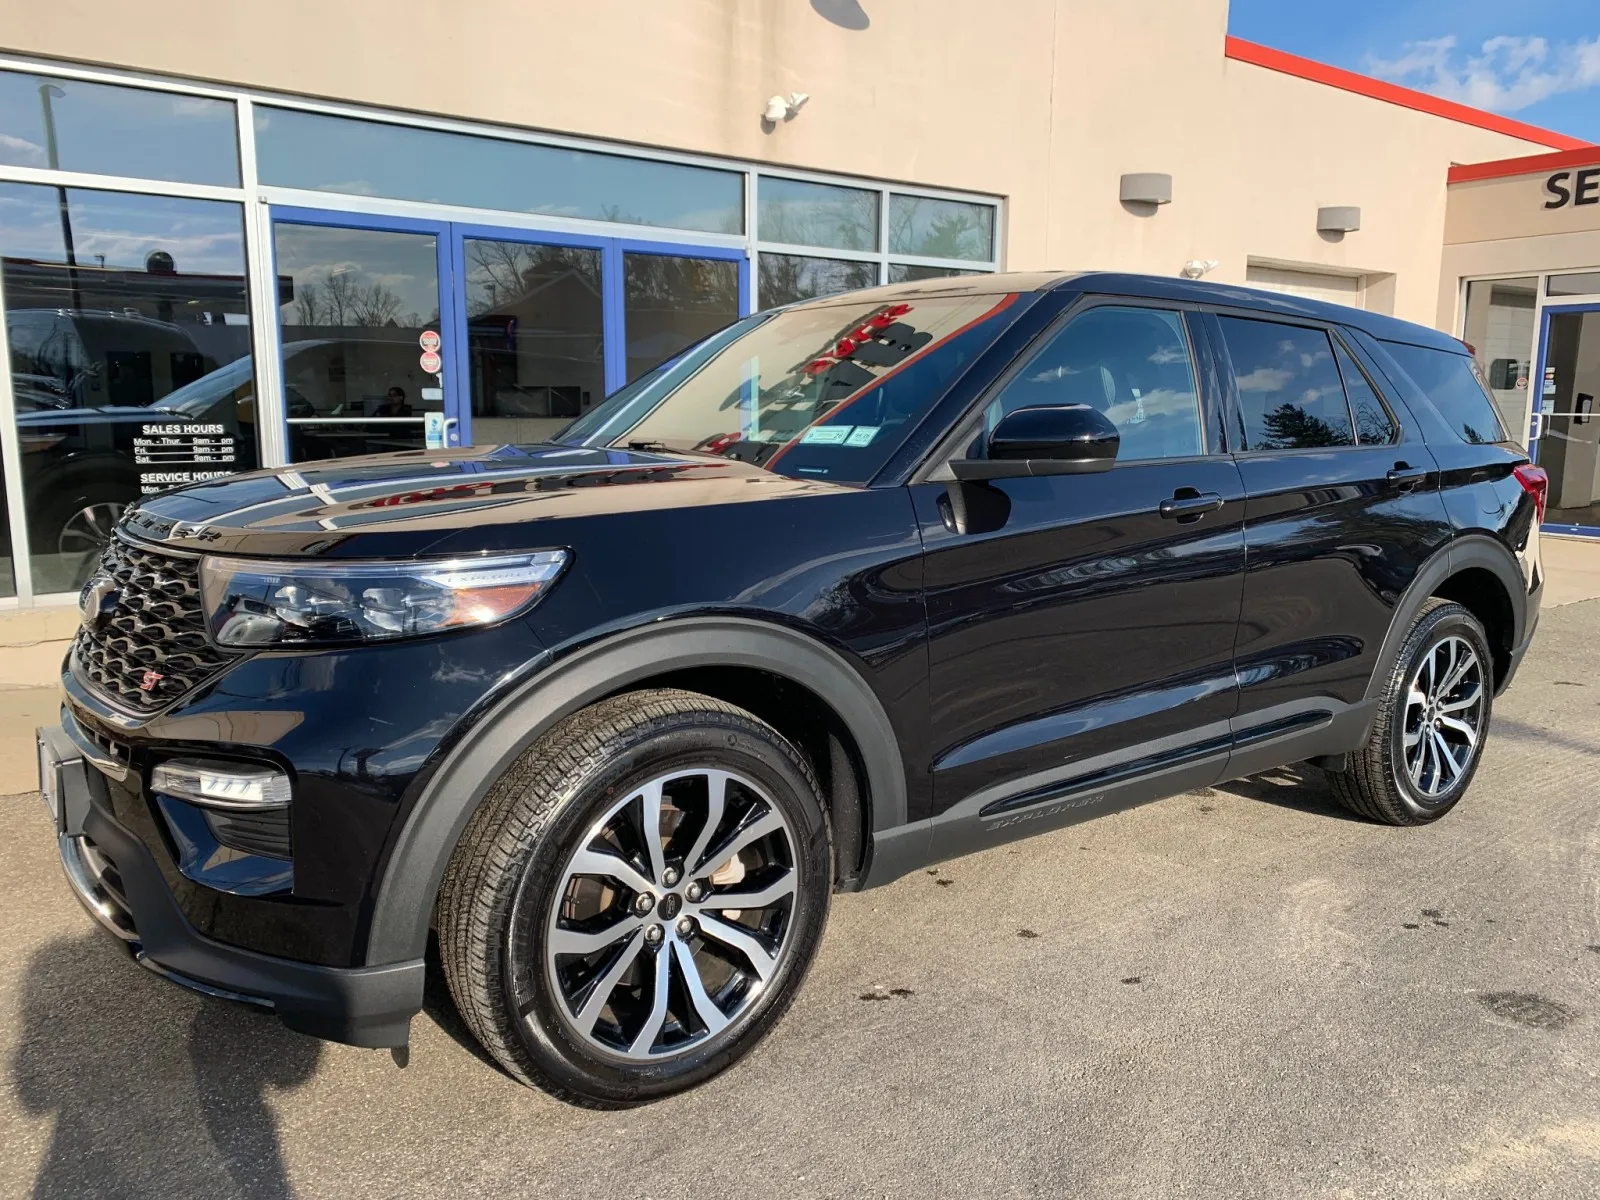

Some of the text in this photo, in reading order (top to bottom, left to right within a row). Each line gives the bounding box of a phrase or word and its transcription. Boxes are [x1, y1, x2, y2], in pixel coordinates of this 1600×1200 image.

[1545, 168, 1600, 209] SE
[142, 424, 224, 434] SALES HOURS
[193, 437, 210, 445] 9am
[140, 472, 190, 483] SERVICE
[140, 671, 164, 691] ST
